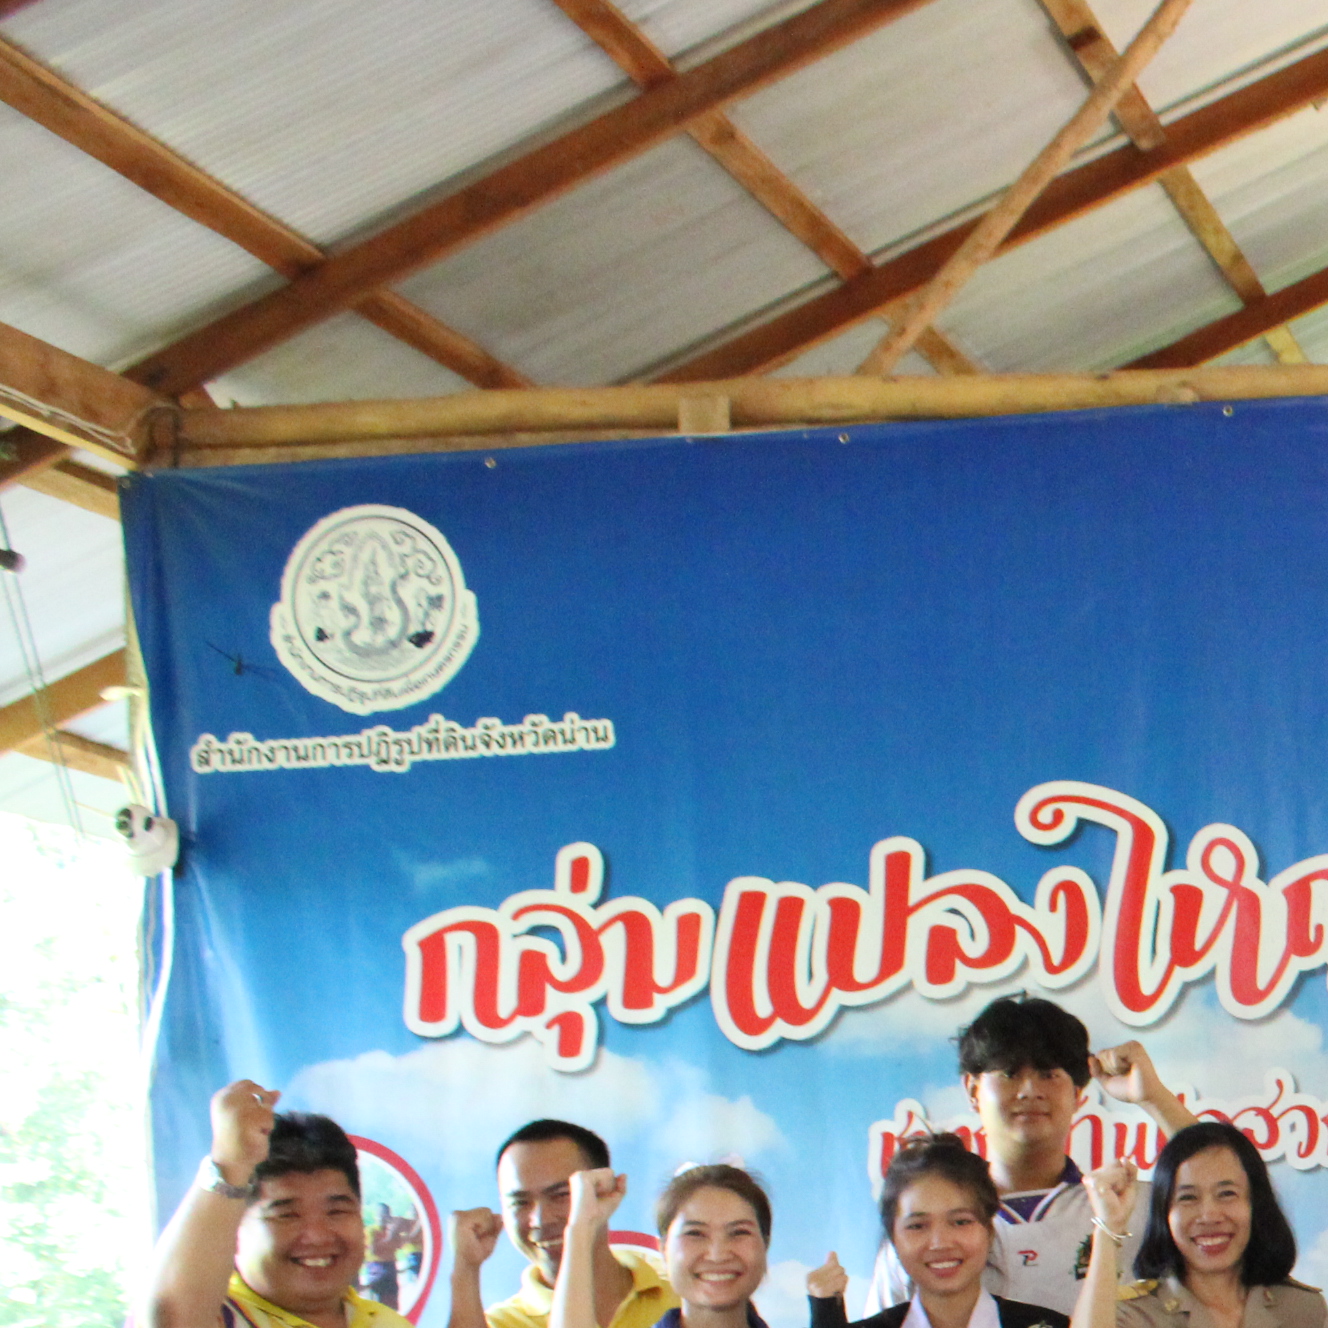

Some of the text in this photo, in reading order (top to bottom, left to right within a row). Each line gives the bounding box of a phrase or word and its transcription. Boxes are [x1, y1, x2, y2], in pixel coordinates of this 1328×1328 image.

[192, 716, 611, 768] สำนักงานการปฏิรูปที่ดินจังหวัดน่าน
